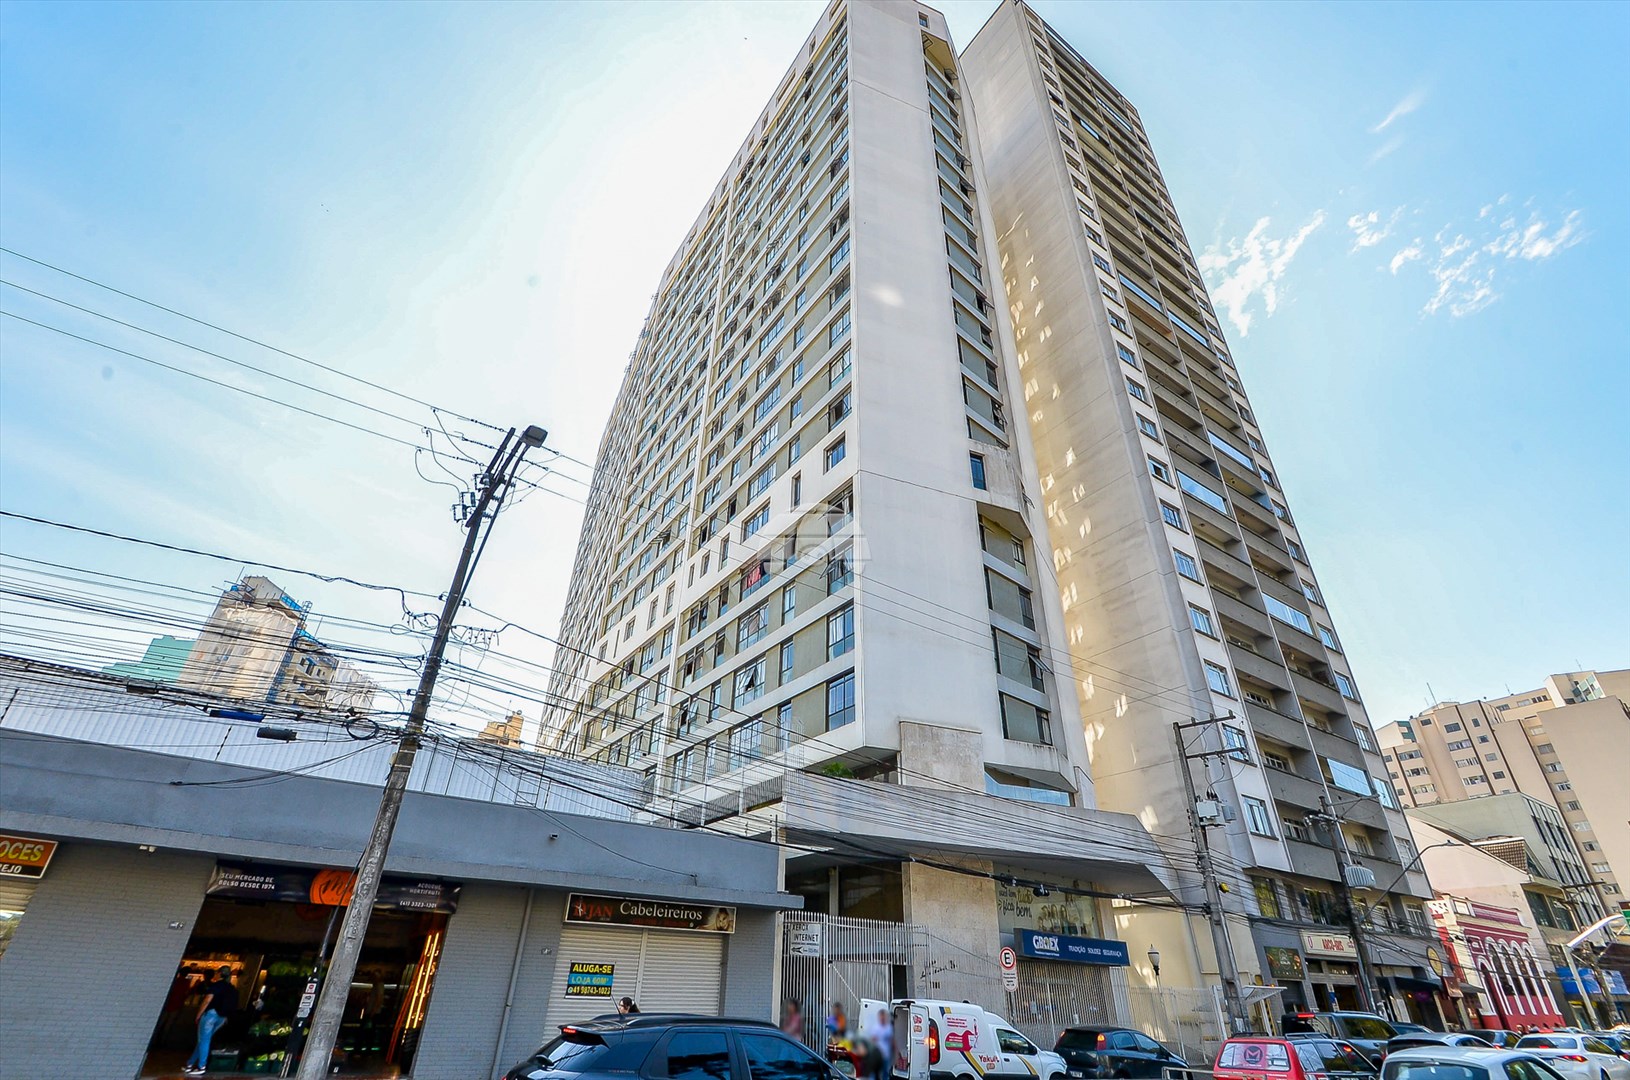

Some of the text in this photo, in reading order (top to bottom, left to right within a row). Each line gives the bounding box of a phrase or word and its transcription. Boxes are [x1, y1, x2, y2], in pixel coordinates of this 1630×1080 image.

[0, 863, 22, 874] EJO
[235, 874, 265, 883] MERCADO
[240, 882, 261, 890] DESDE
[619, 901, 703, 921] Cabeleireiros
[793, 933, 819, 943] INTERNET
[572, 963, 613, 974] ALUGA-SE
[978, 1054, 1000, 1064] Yakult
